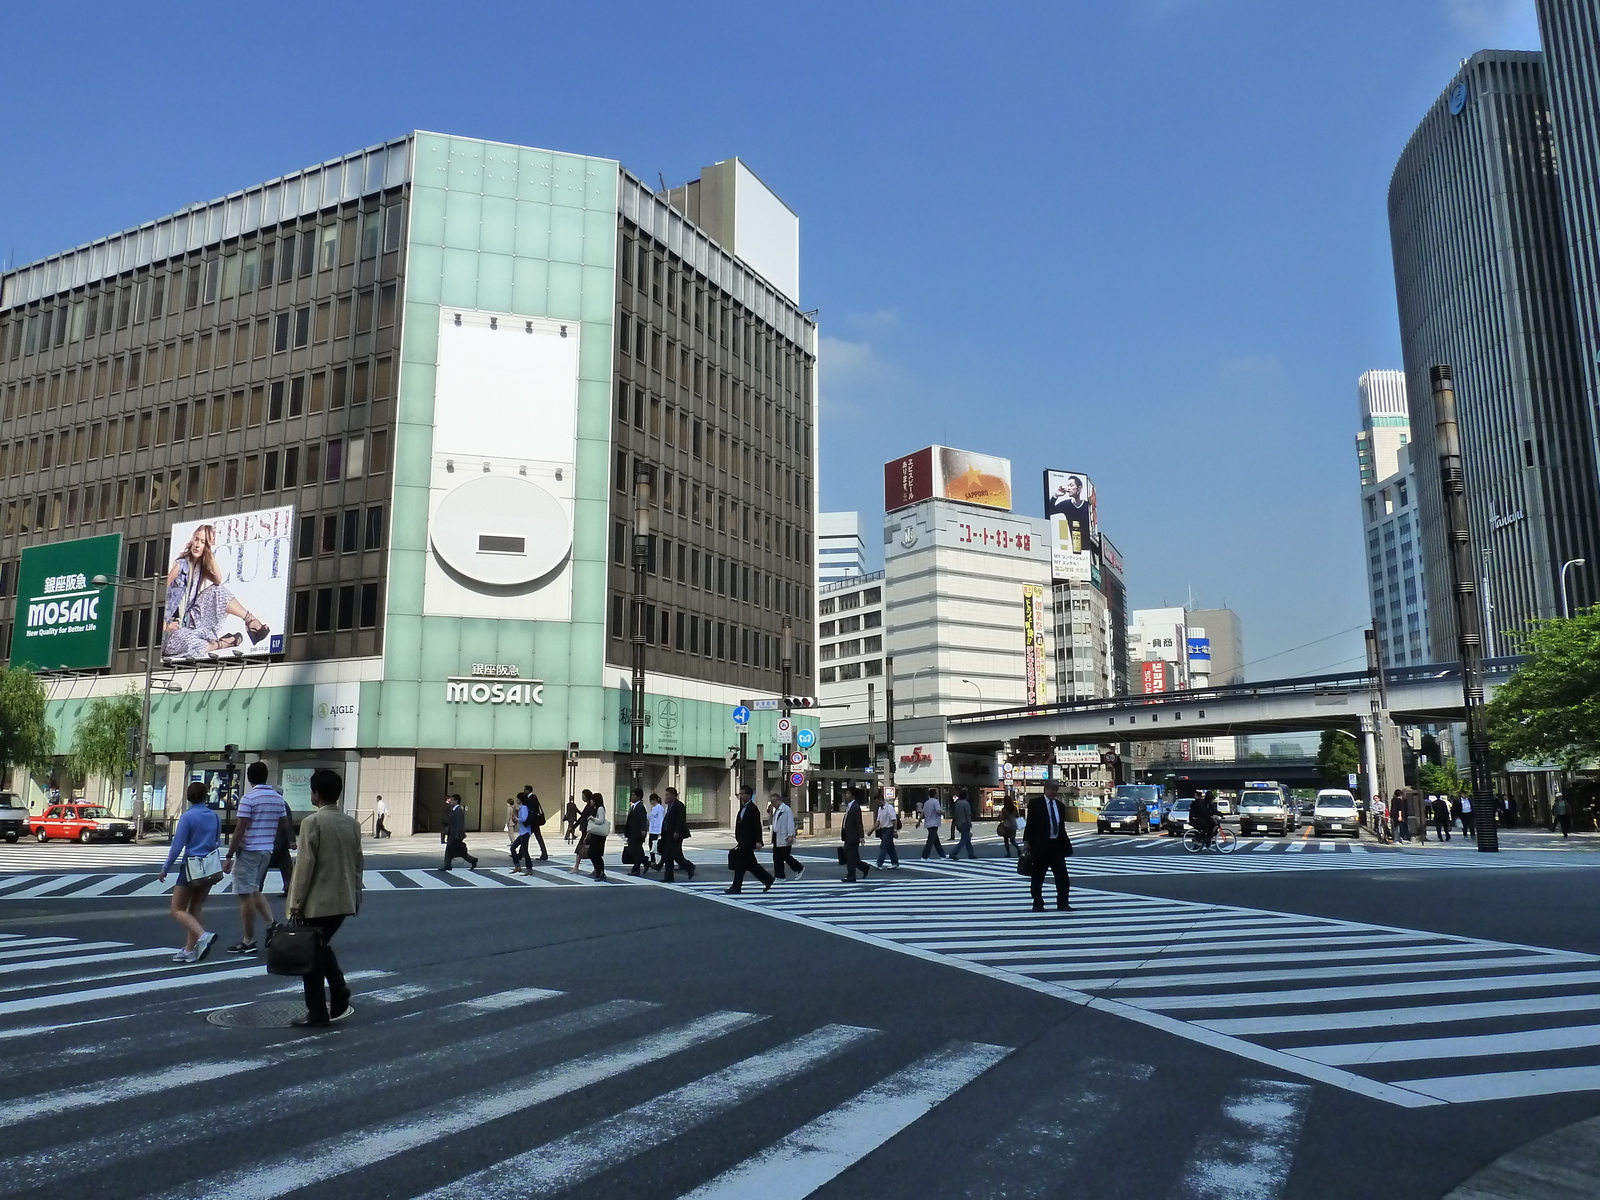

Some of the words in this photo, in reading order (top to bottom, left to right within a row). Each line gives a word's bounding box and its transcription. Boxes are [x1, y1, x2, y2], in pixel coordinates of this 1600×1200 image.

[964, 489, 989, 500] SAPPORO
[211, 510, 289, 546] FRESH
[213, 536, 290, 583] CUT
[44, 573, 86, 593] 銀座阪急
[27, 596, 99, 627] MOSAIC
[26, 629, 39, 637] New
[39, 628, 58, 636] Quality
[59, 626, 67, 634] for
[68, 625, 85, 633] Better
[85, 623, 97, 631] Life
[272, 639, 281, 648] GAP
[471, 662, 520, 676] 銀座阪急
[446, 682, 543, 704] MOSAIC
[330, 705, 354, 715] AIGLE
